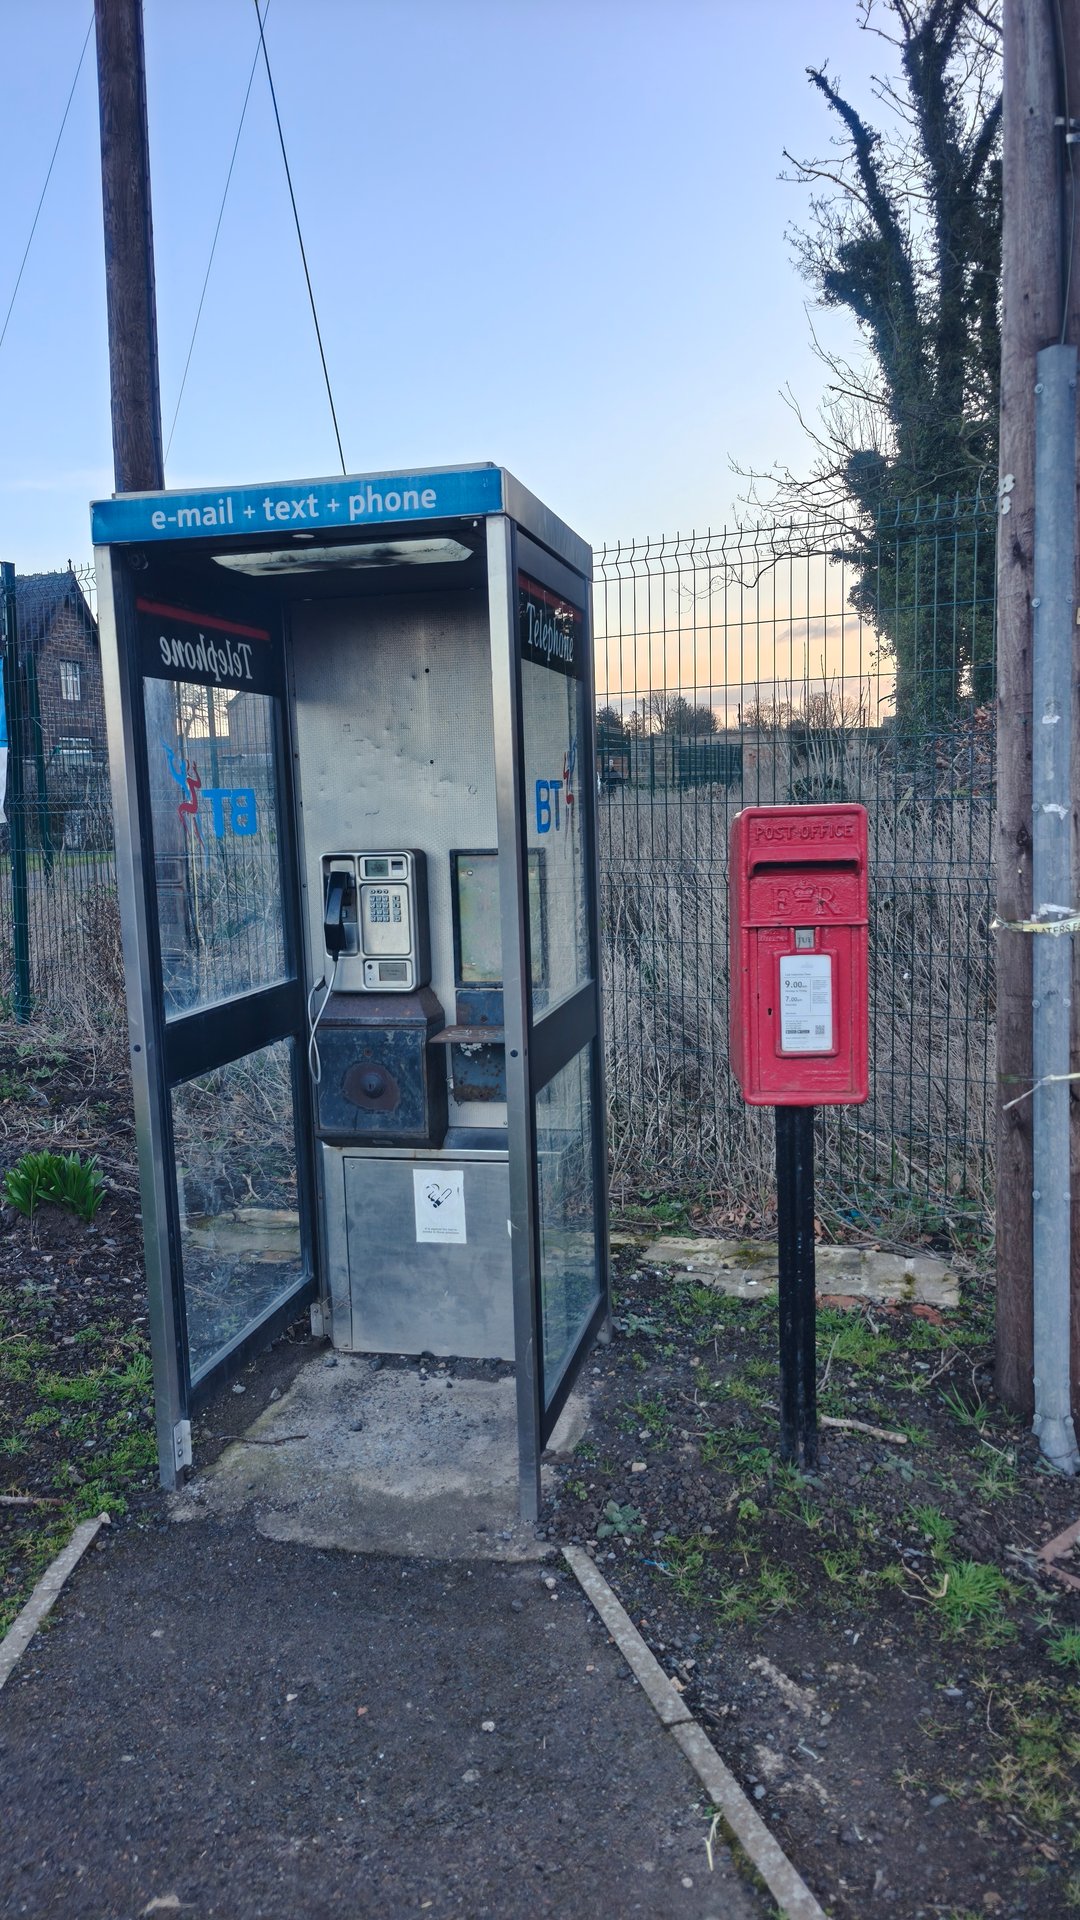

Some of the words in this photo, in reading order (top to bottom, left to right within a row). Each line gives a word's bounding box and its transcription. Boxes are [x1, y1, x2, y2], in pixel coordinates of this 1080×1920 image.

[151, 496, 233, 530] e-mail
[262, 495, 319, 522] text
[349, 485, 437, 521] phone
[526, 602, 574, 663] Telephone
[535, 779, 563, 834] BT
[755, 825, 793, 841] POST
[799, 824, 854, 840] OFFICE
